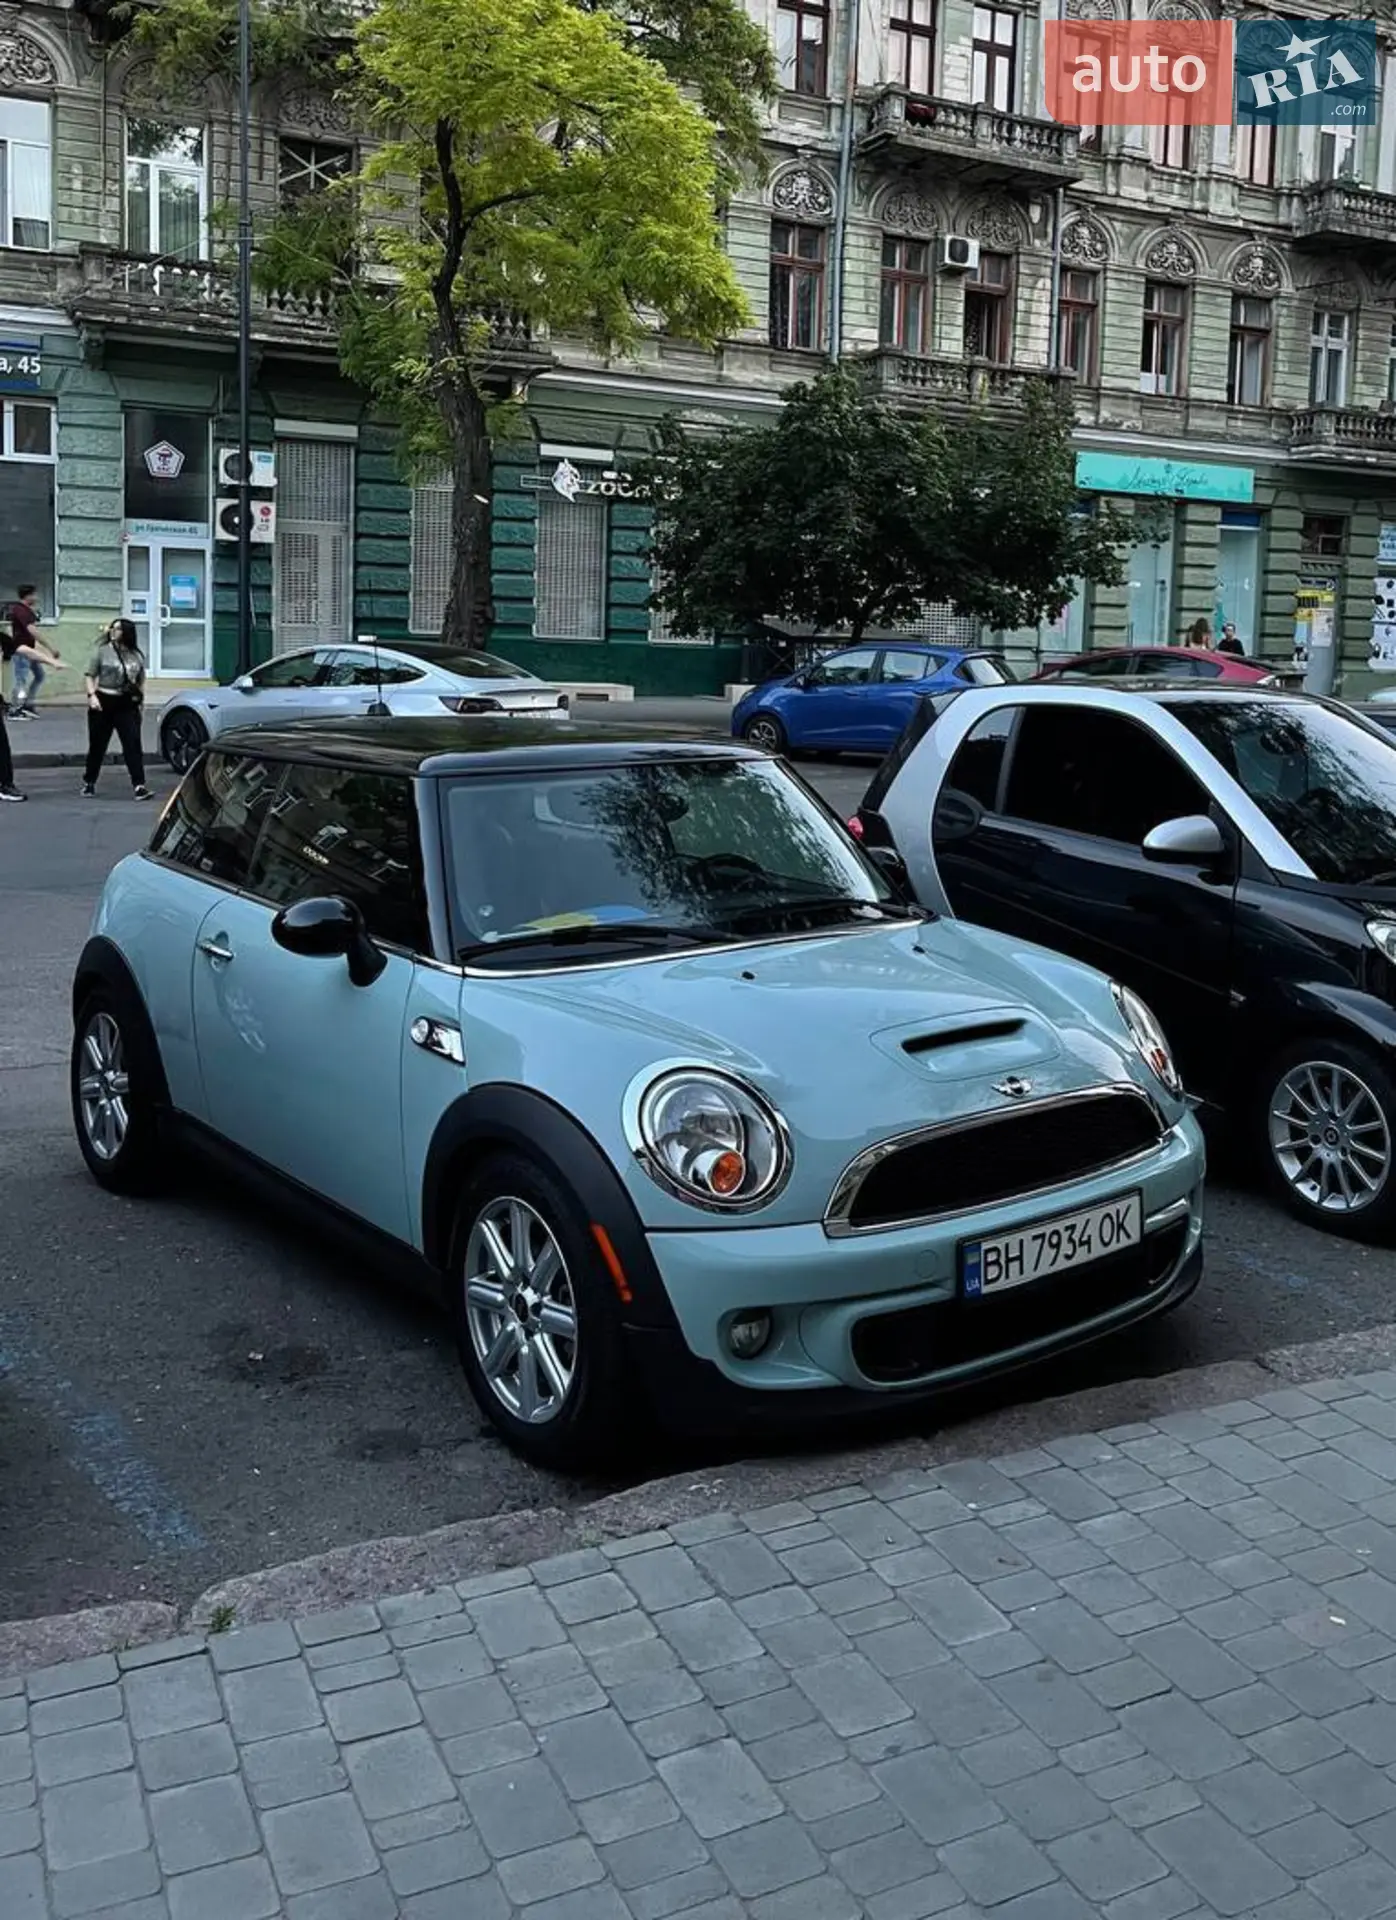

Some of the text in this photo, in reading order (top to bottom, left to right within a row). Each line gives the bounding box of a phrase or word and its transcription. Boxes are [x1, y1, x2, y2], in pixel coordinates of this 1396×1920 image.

[17, 355, 41, 374] 45
[983, 1203, 1132, 1286] BH 7934 OK
[966, 1280, 980, 1291] UA
